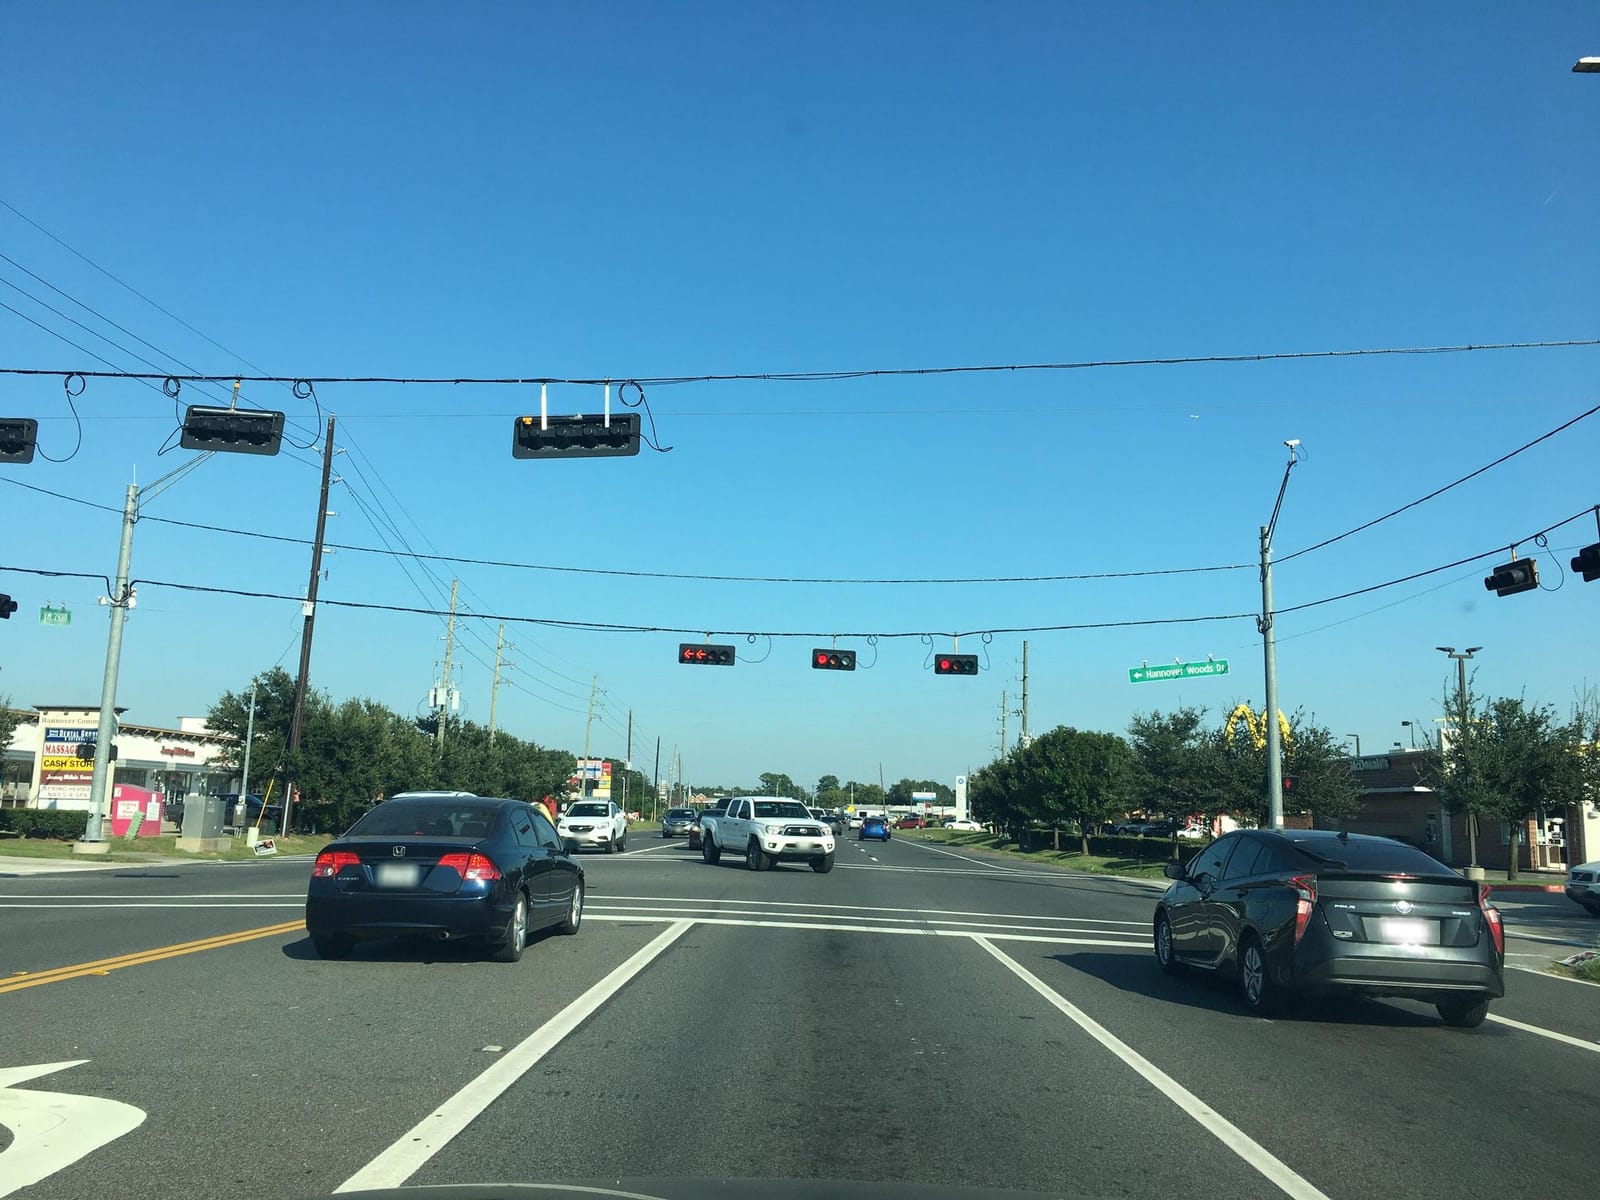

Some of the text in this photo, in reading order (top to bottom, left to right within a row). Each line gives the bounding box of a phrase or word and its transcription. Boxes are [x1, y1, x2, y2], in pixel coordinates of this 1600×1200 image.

[1145, 663, 1225, 678] Hannover Woods Dr
